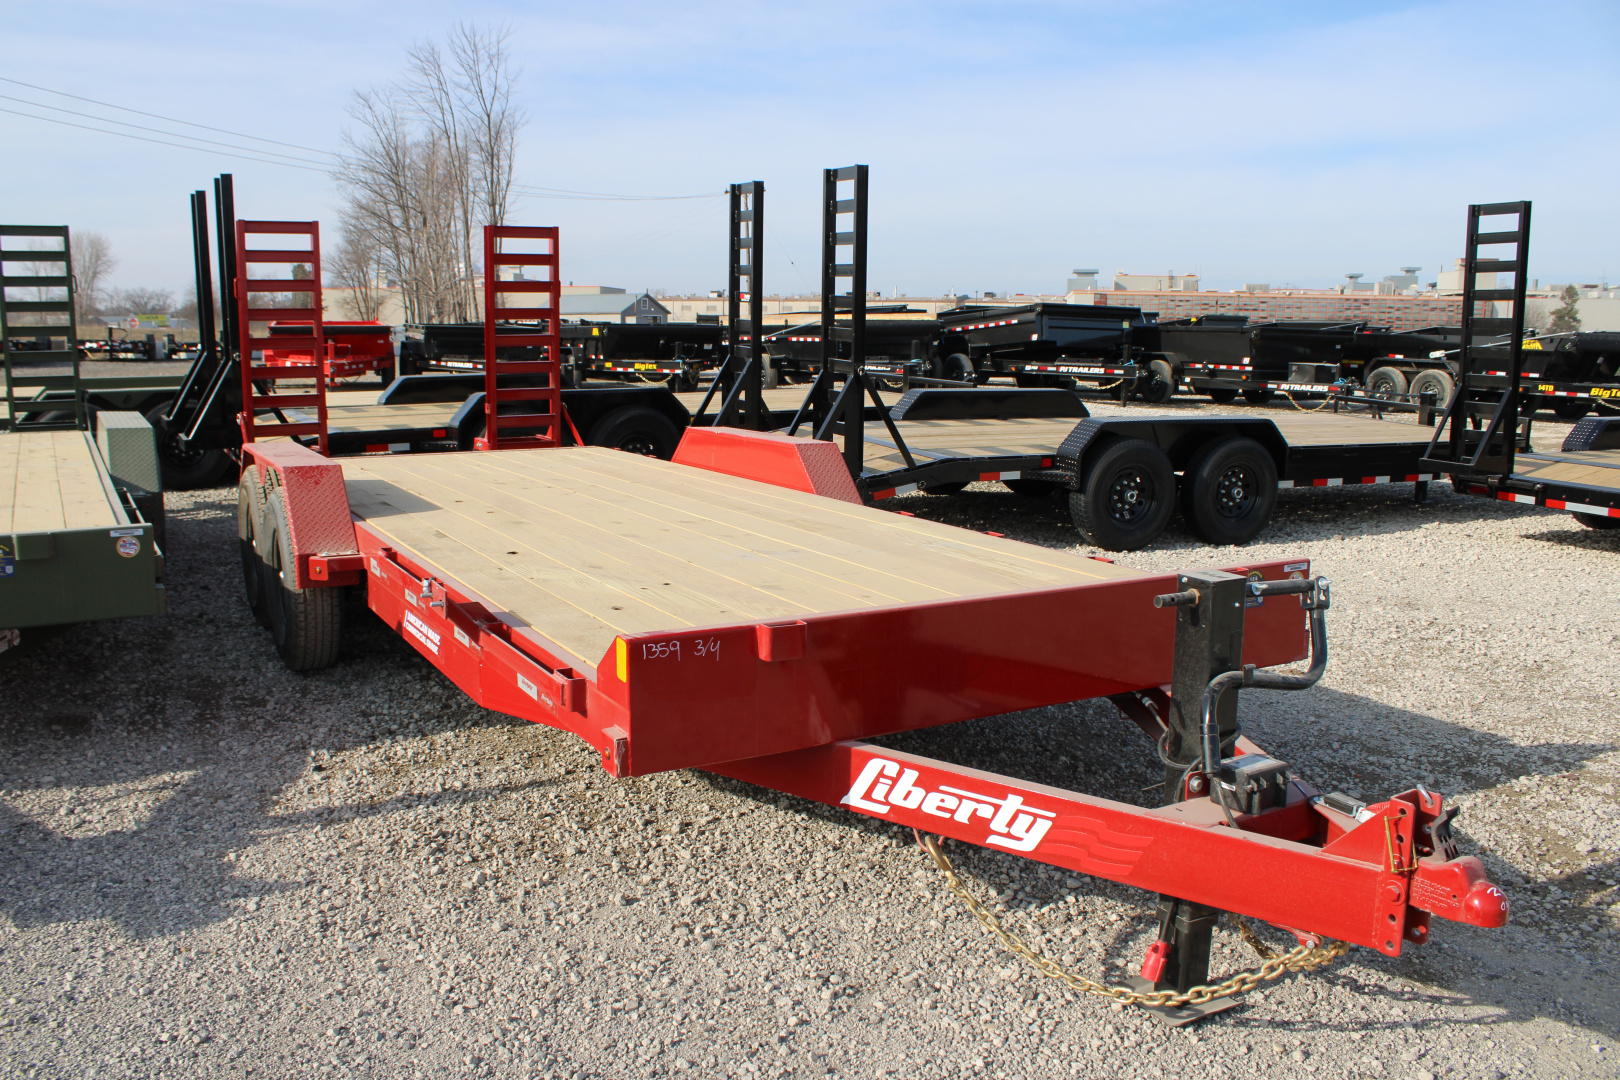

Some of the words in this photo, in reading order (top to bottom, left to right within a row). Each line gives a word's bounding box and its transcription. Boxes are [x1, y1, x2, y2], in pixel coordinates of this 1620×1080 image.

[634, 362, 657, 371] BigTex
[1289, 384, 1329, 392] TRAILERS
[642, 640, 680, 662] 1359
[693, 636, 720, 662] 3/4
[840, 757, 1057, 852] Liberty
